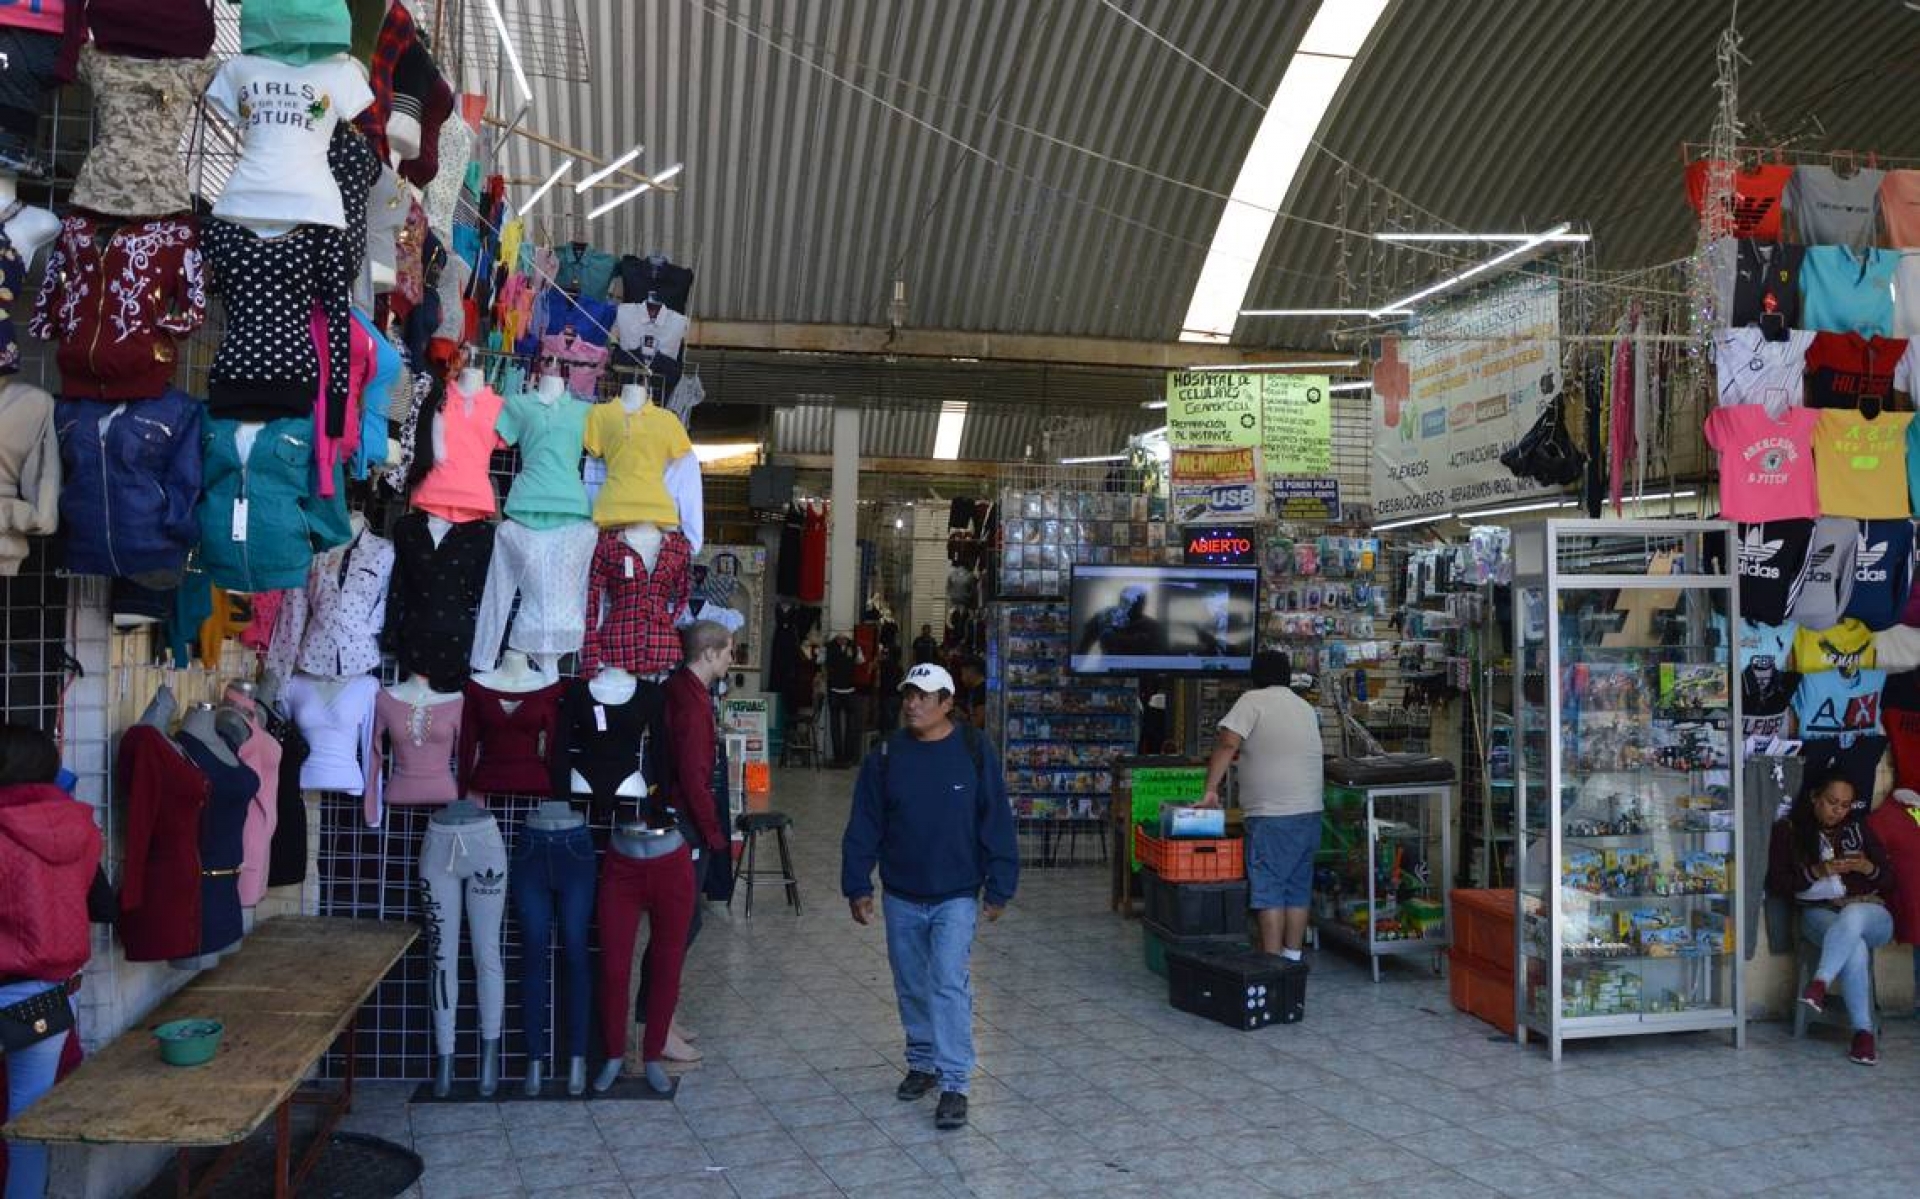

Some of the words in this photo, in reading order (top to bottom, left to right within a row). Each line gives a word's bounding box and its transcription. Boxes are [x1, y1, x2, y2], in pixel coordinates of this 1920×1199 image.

[241, 81, 315, 101] GIRLS
[277, 100, 299, 109] THE
[1174, 372, 1234, 387] HOSPITAL
[1175, 451, 1252, 472] MEMORIAS
[1212, 488, 1254, 506] USB
[1189, 538, 1250, 553] ABIERTO
[1739, 561, 1779, 579] didas
